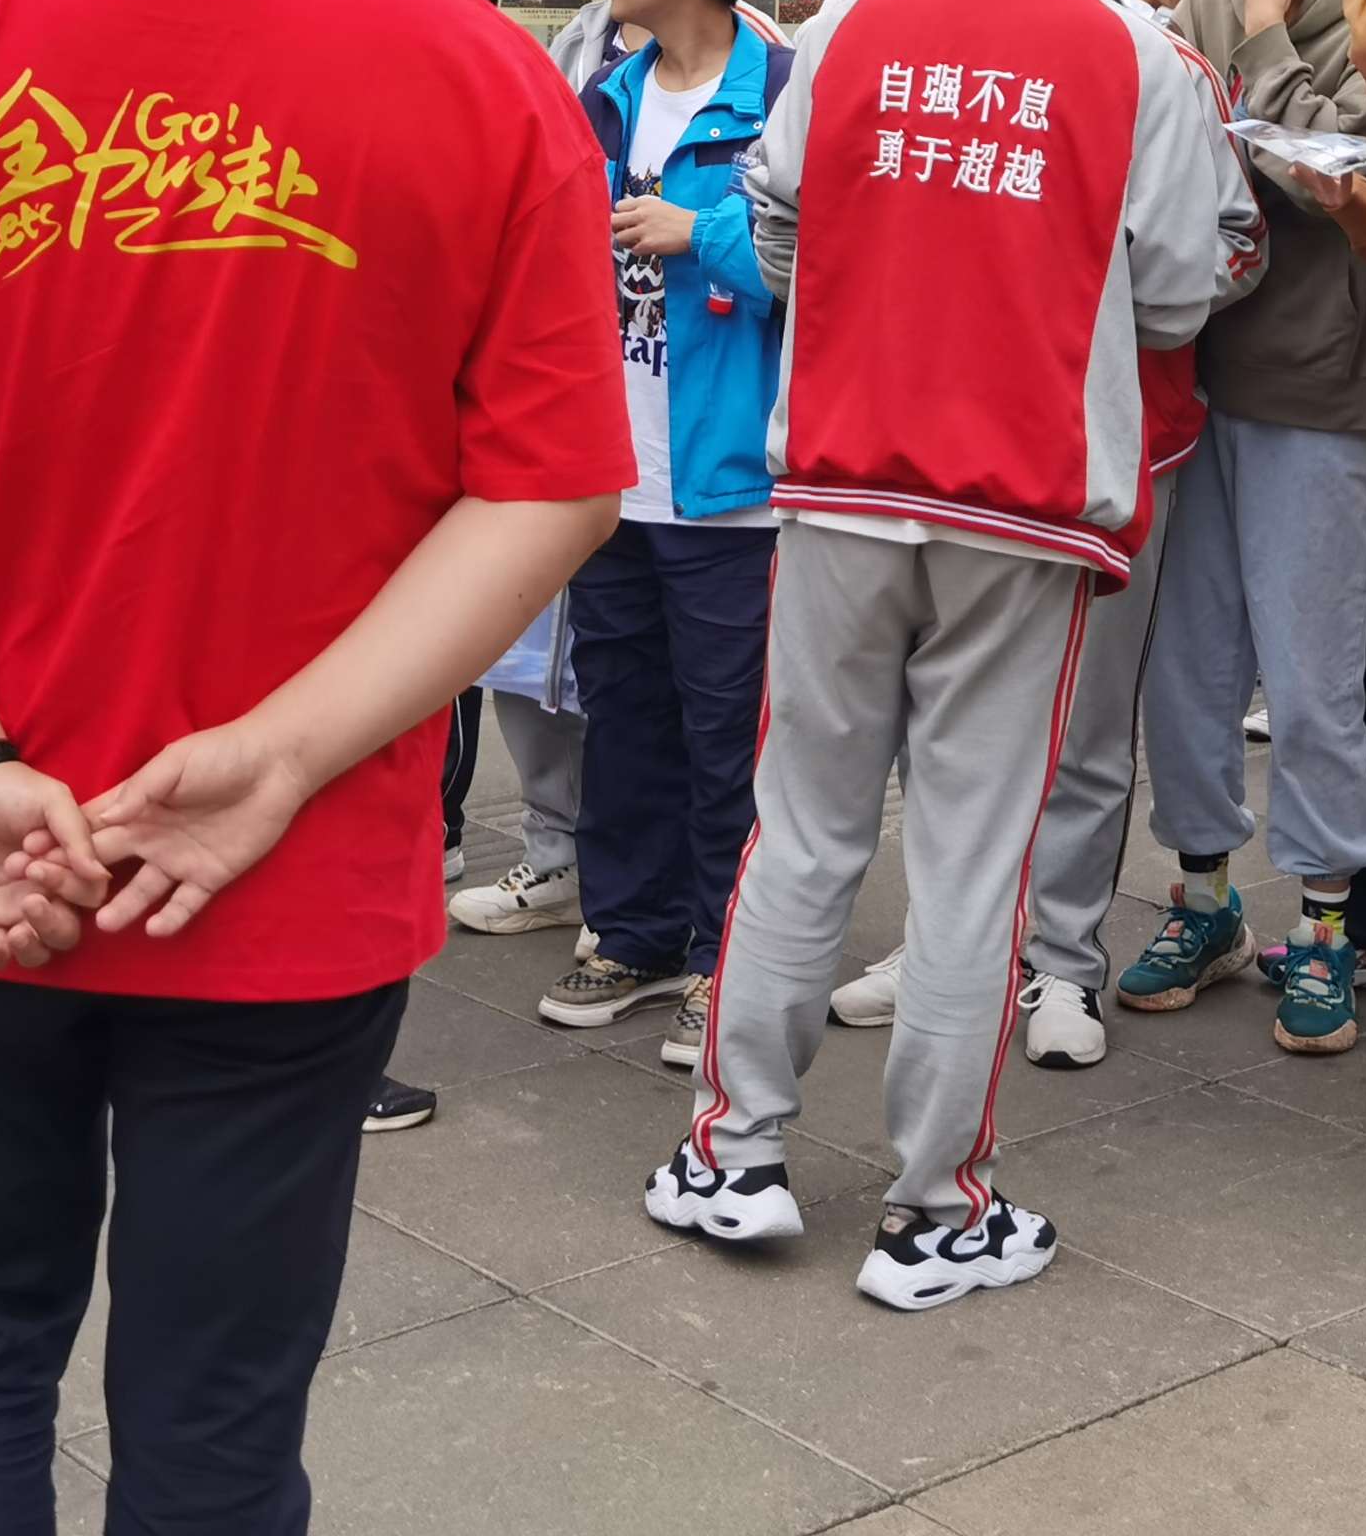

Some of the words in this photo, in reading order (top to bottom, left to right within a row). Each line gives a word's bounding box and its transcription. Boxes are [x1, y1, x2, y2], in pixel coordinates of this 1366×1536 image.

[135, 91, 241, 151] Go!
[878, 60, 1055, 132] 自强不息
[869, 128, 1046, 201] 勇于超越
